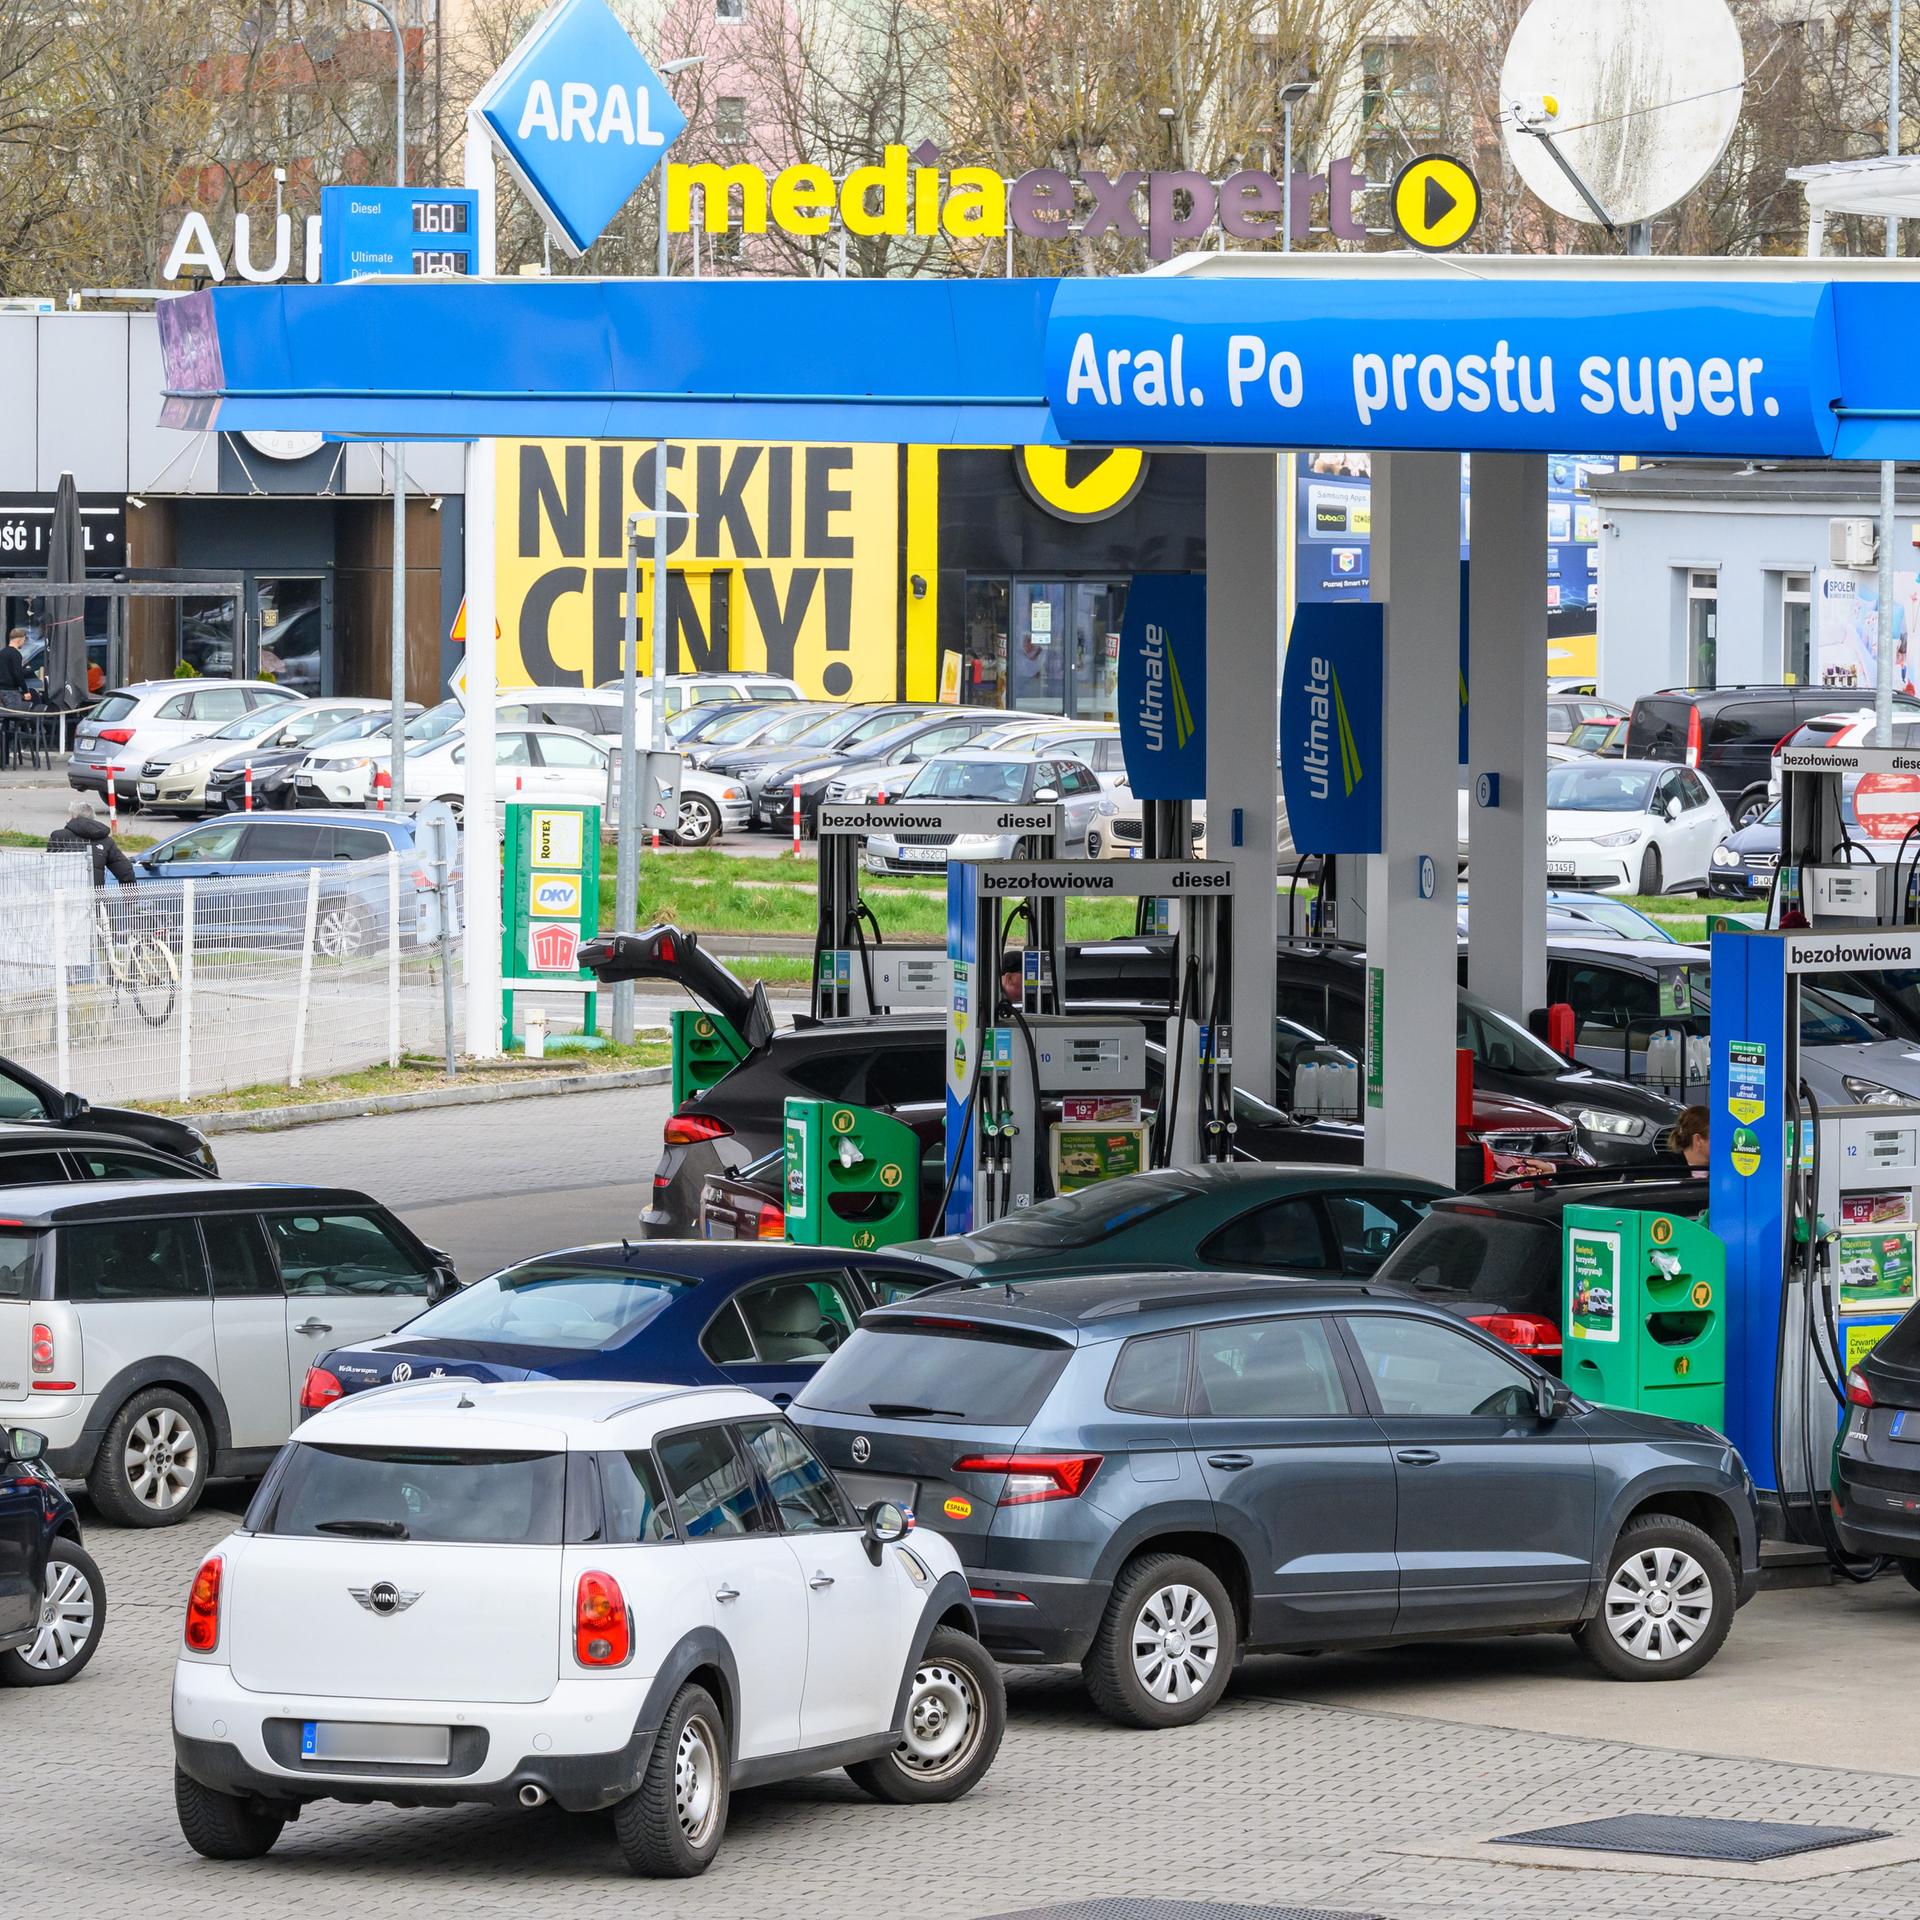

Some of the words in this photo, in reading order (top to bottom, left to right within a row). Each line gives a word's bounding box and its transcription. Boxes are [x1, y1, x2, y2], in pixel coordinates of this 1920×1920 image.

[517, 79, 665, 146] ARAL
[351, 201, 381, 214] Diesel
[351, 251, 393, 263] Ultimate
[1066, 332, 1204, 407] Aral.
[1227, 335, 1303, 408] Po
[1353, 340, 1555, 426] prostu
[1580, 356, 1780, 431] super.
[518, 445, 854, 559] NISKIE
[0, 520, 28, 551] ŚĆ
[1323, 581, 1344, 589] Poznaj
[1344, 580, 1361, 588] Smart
[518, 566, 854, 697] CENY!
[1139, 623, 1163, 752] ultimate
[1303, 656, 1330, 800] ultimate
[1783, 753, 1859, 767] bezołowiowa
[1481, 782, 1487, 798] 6
[821, 812, 942, 829] bezołowiowa
[996, 812, 1052, 828] diesel
[541, 820, 551, 859] ROUTEX
[983, 872, 1114, 889] bezołowiowa
[1171, 871, 1231, 888] diesel
[1424, 868, 1432, 888] 10
[539, 888, 574, 902] DKV
[534, 926, 576, 967] UTA
[1791, 944, 1912, 964] bezołowiowa
[883, 974, 890, 983] 8
[1040, 1053, 1051, 1063] 10
[1076, 1105, 1087, 1115] 19
[1847, 1146, 1857, 1157] 12
[1853, 1205, 1863, 1216] 19
[373, 1593, 398, 1603] MINI
[306, 1740, 313, 1749] D
